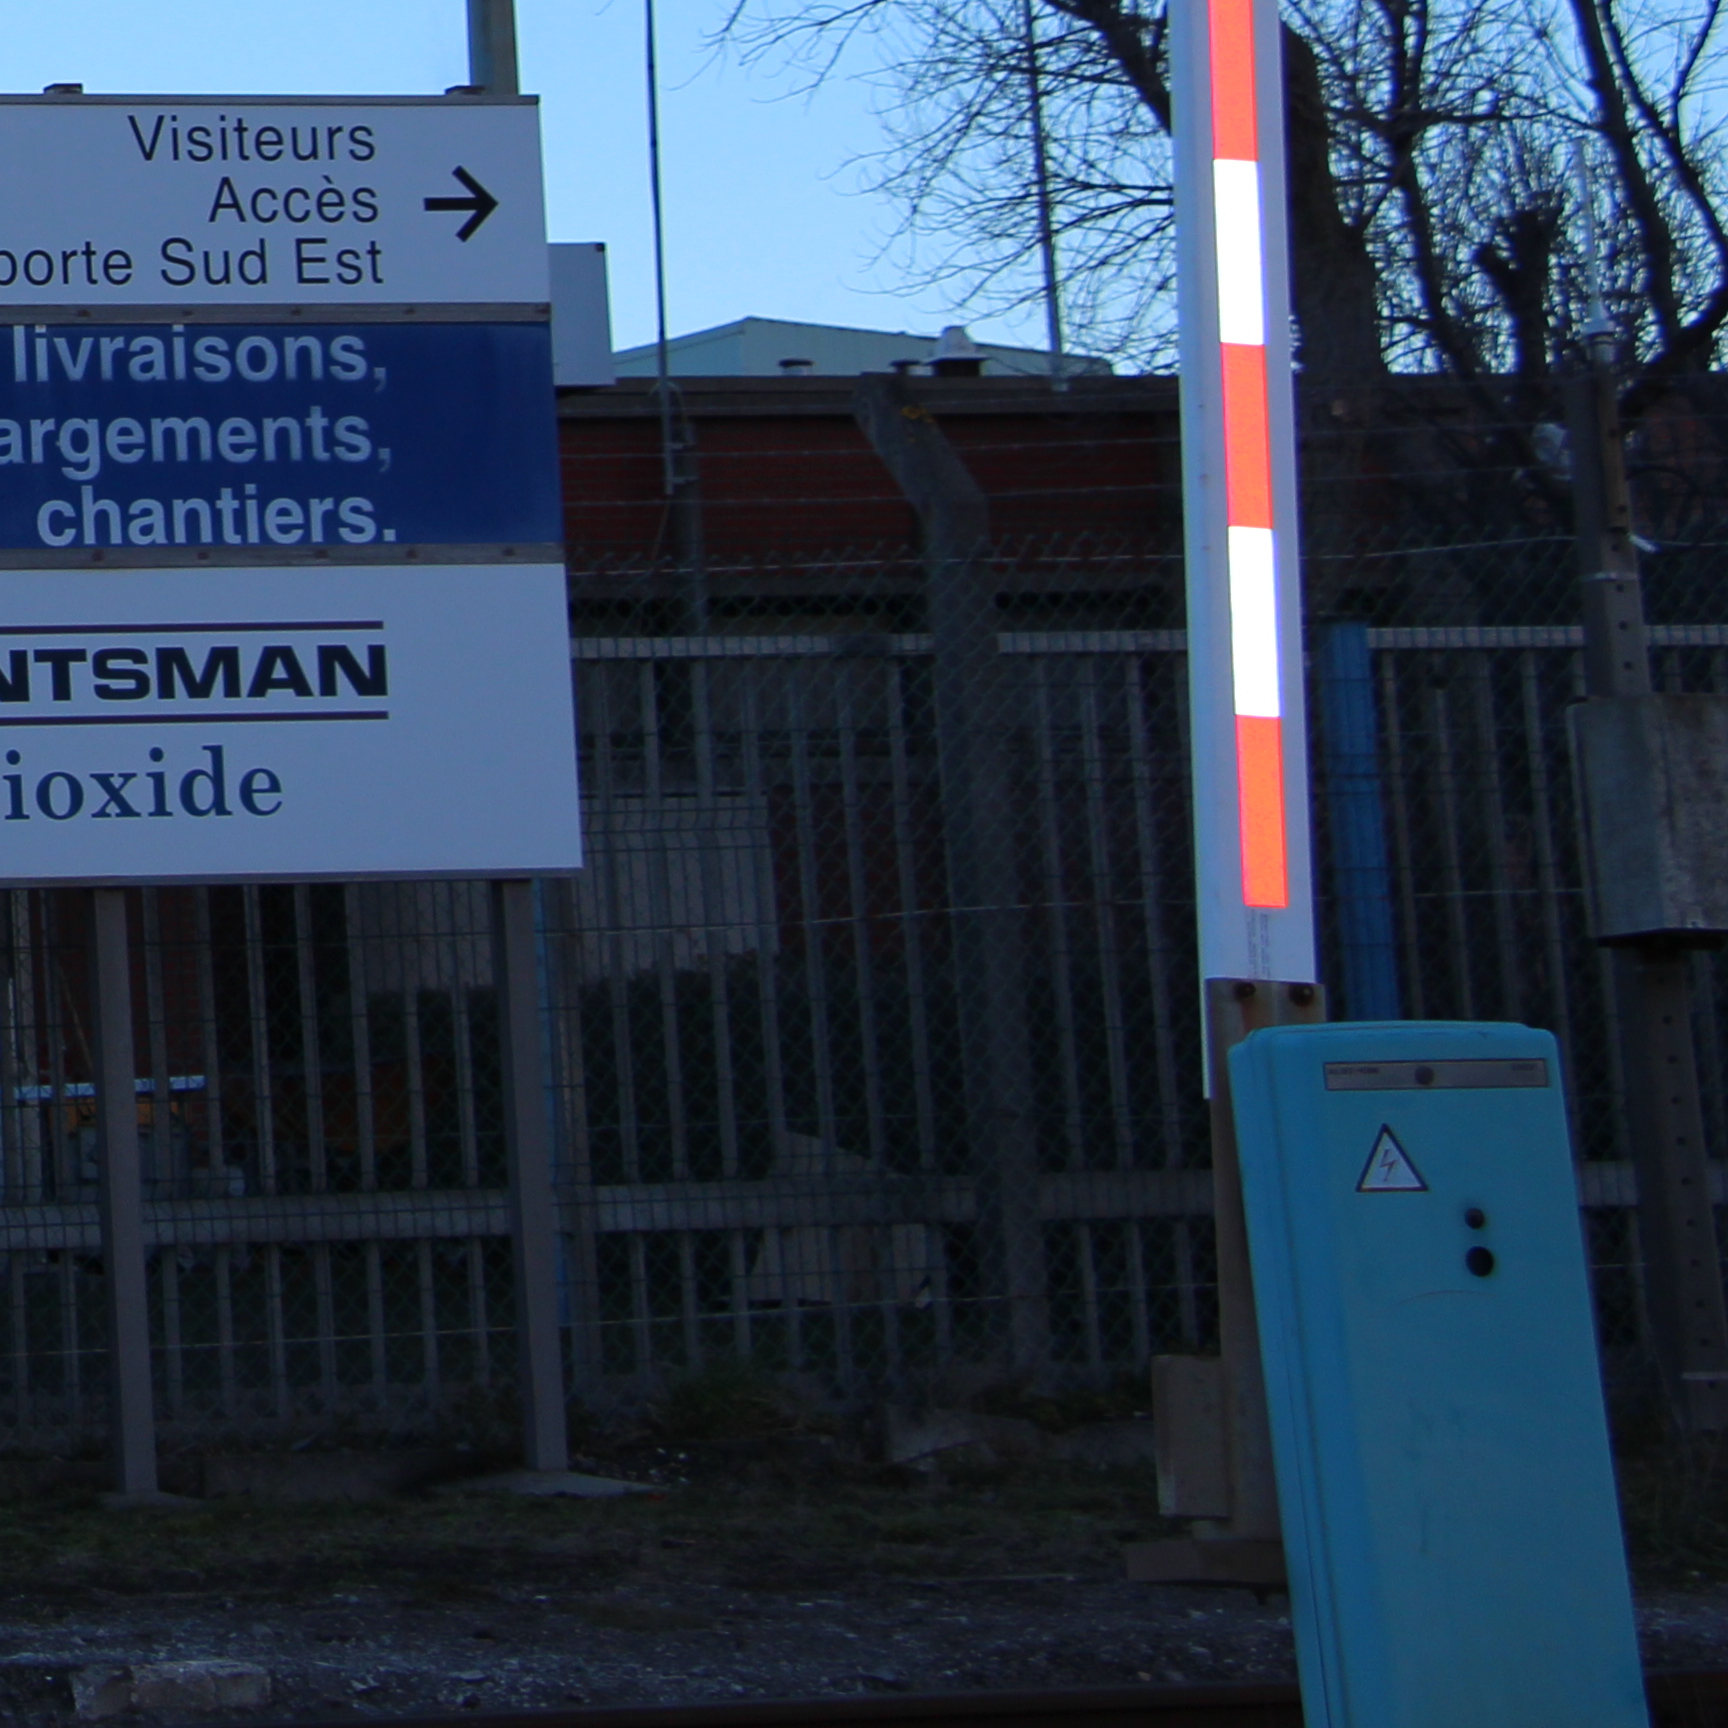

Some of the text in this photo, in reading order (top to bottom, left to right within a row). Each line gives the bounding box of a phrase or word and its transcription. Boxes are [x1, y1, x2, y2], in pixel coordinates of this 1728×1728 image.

[127, 114, 376, 162] Visiteurs
[208, 174, 379, 223] Accès
[160, 237, 268, 286] Sud
[295, 237, 384, 285] Est
[13, 324, 387, 393] livraisons,
[36, 483, 397, 547] chantiers.
